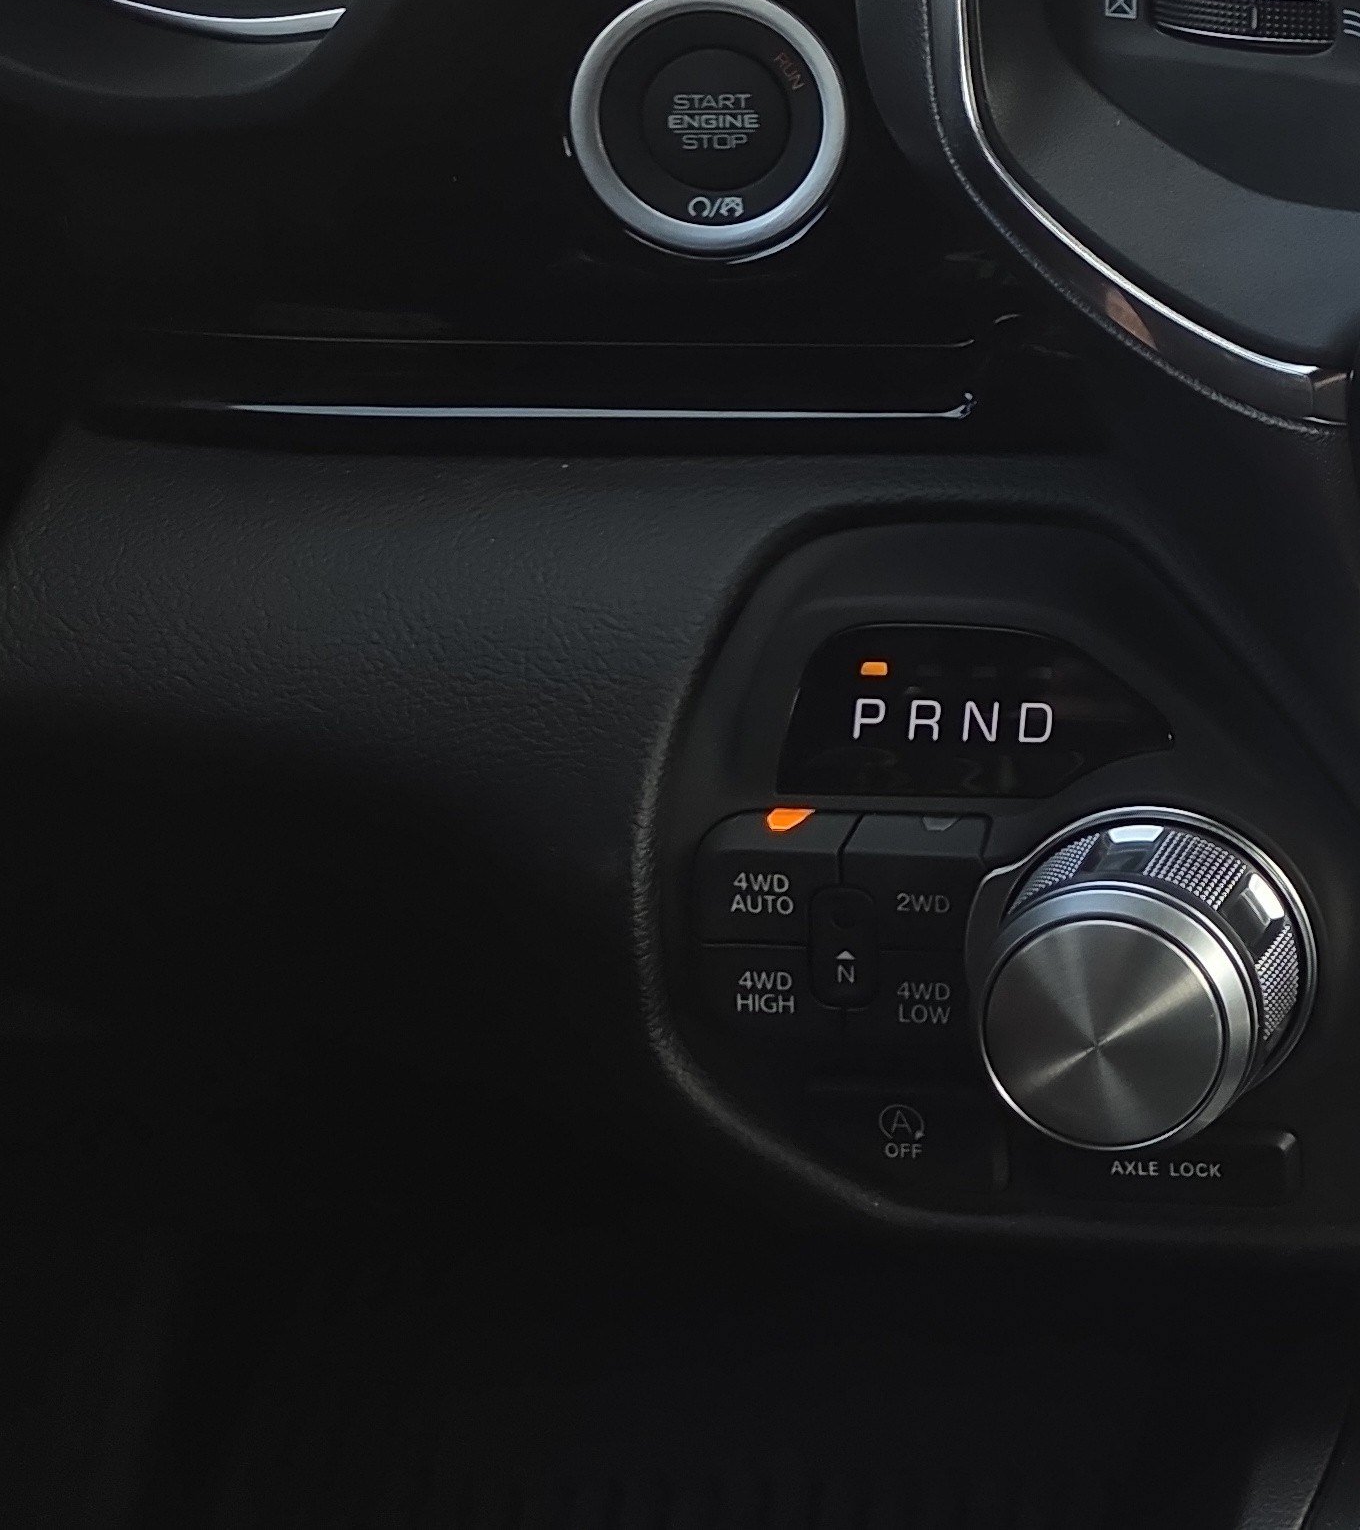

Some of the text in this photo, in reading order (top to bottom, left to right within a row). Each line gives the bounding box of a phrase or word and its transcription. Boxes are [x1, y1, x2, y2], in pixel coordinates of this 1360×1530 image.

[774, 52, 805, 91] RUN
[673, 94, 752, 109] START
[667, 114, 760, 128] ENGINE
[682, 134, 748, 150] STOP
[733, 873, 789, 893] 4WD
[731, 895, 794, 916] AUTO
[896, 894, 950, 913] 2WD
[737, 971, 793, 992] 4WD
[896, 981, 950, 1002] 4WD
[736, 993, 795, 1014] HIGH
[898, 1004, 951, 1025] LOW
[884, 1142, 923, 1159] OFF
[1111, 1160, 1221, 1178] AXLE LOCK
